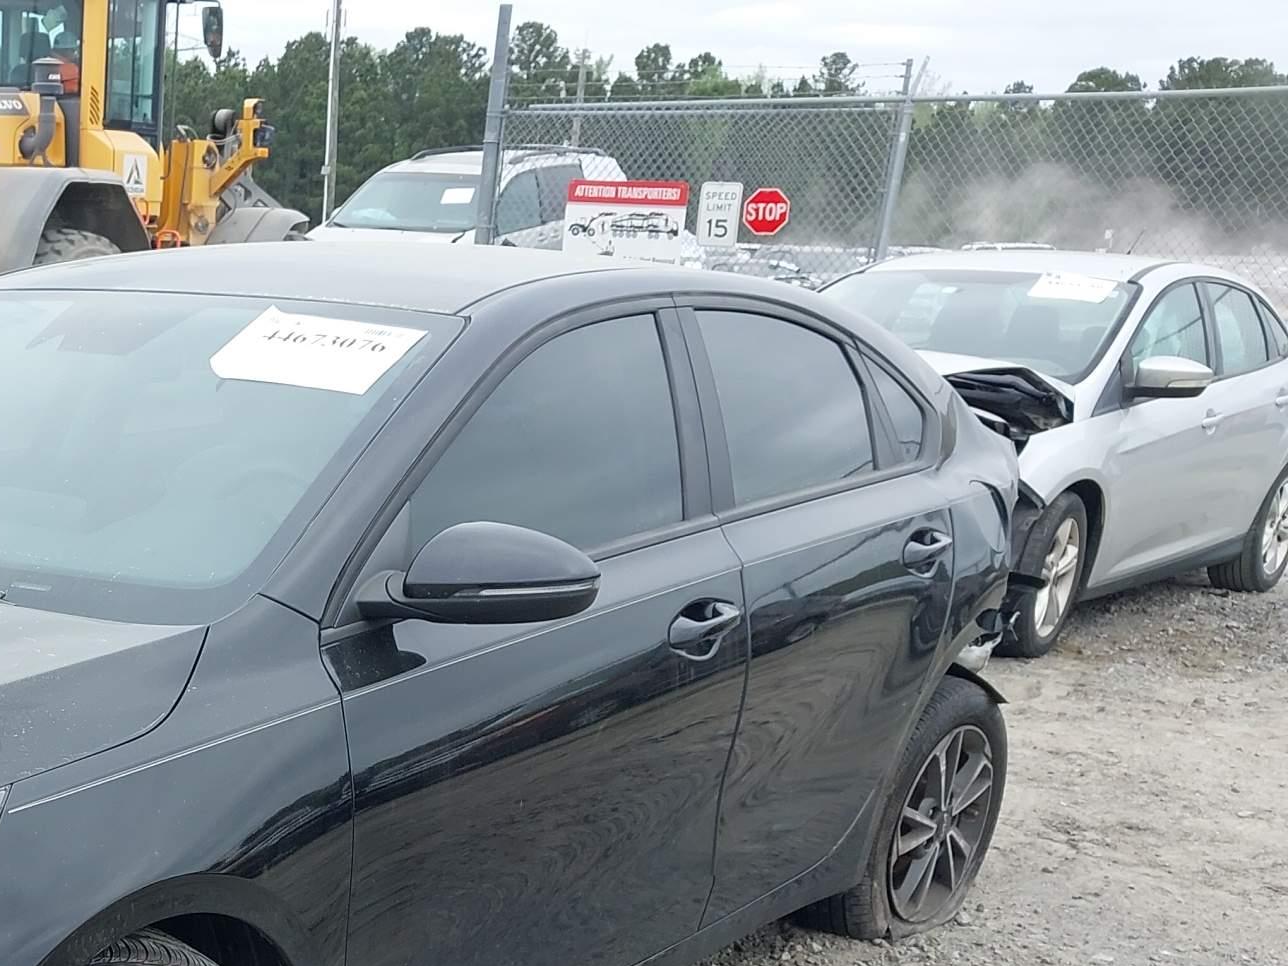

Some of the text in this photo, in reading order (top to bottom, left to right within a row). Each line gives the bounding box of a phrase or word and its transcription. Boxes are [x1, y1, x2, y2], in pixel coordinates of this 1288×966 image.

[574, 184, 617, 199] ATTENTION
[704, 191, 737, 201] SPEED
[706, 203, 732, 212] LIMIT
[746, 202, 787, 222] STOP
[706, 219, 728, 238] 15
[263, 329, 387, 353] 44673076
